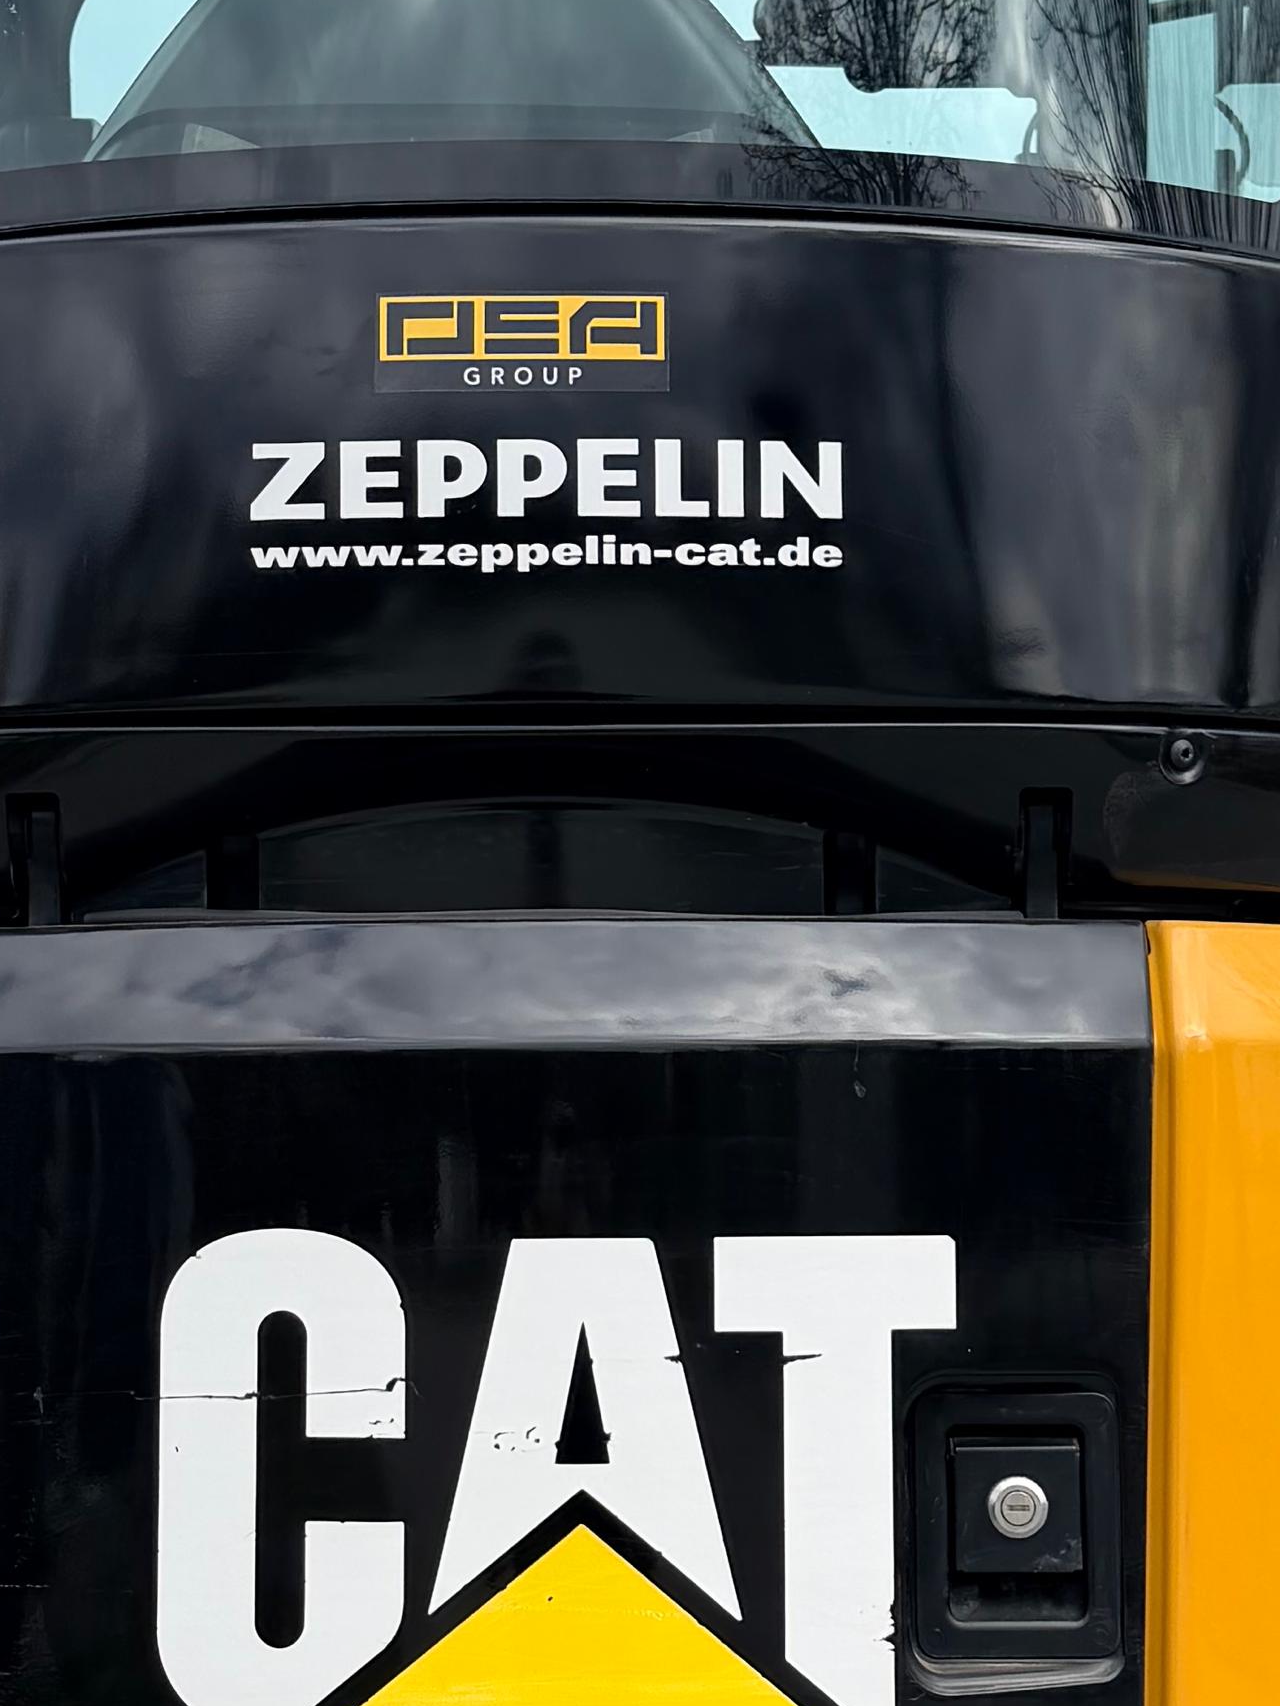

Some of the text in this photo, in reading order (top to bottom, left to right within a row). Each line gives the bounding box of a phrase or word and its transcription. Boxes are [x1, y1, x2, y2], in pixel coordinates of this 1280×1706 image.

[463, 366, 582, 386] GROUP
[249, 438, 843, 521] ZEPPELIN
[250, 534, 843, 573] www.zeppelin-cat.de
